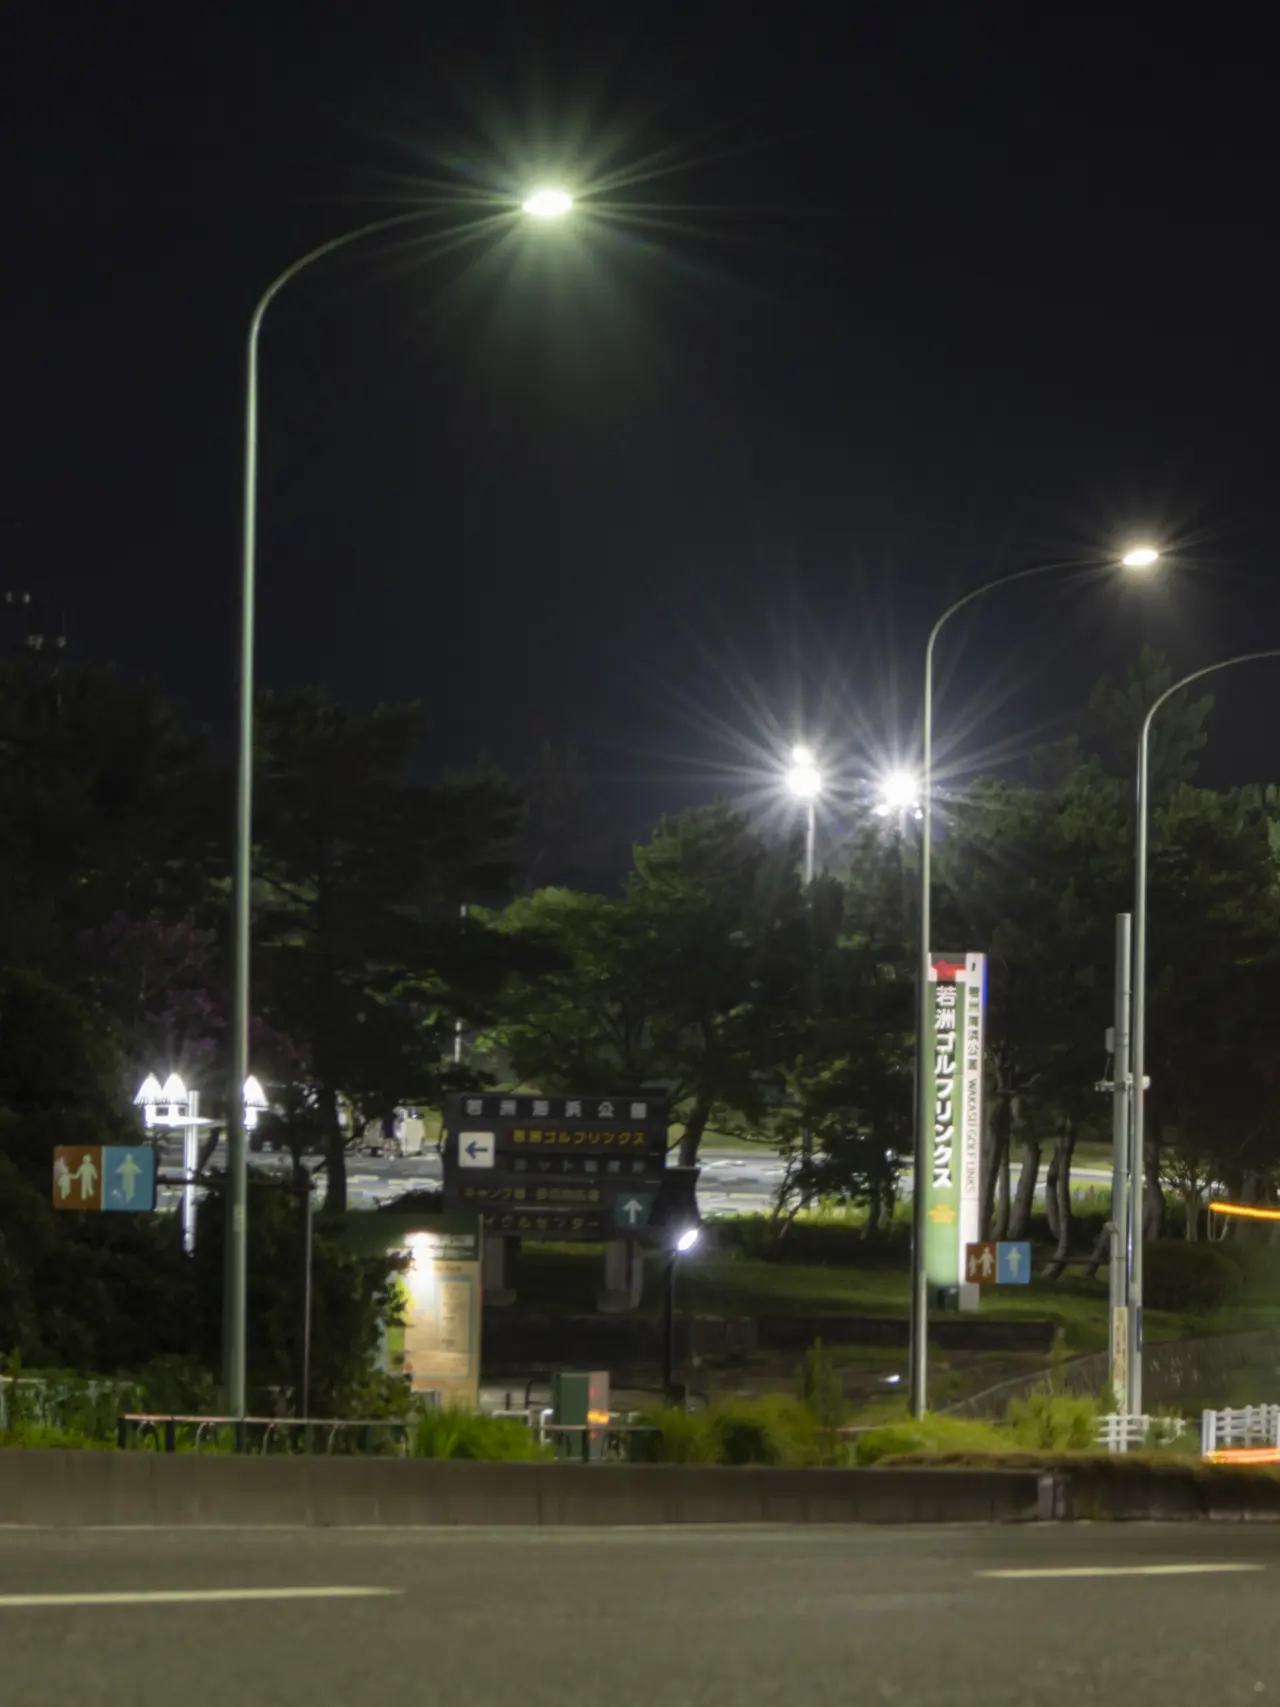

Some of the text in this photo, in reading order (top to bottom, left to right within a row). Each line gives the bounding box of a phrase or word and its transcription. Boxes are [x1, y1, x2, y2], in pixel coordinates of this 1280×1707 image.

[933, 985, 956, 1188] 若洲ゴルフリンクス
[967, 1078, 977, 1126] WAKASU
[966, 1129, 977, 1158] GOLF
